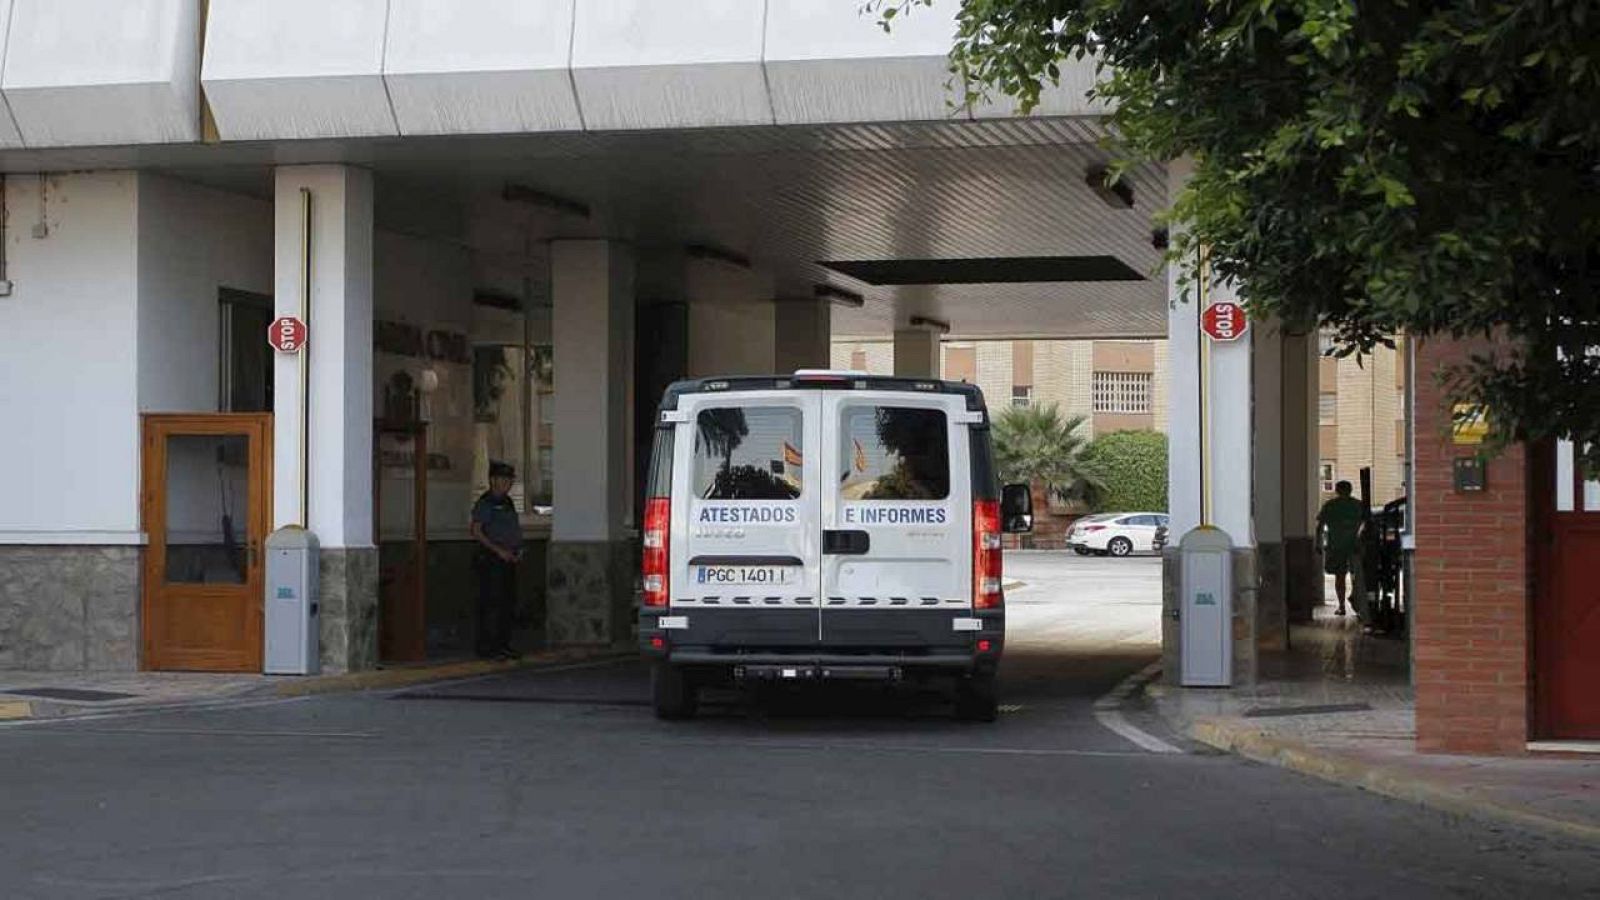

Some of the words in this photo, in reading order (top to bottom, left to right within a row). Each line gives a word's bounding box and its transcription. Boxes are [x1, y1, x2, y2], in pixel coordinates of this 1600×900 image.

[1215, 304, 1233, 337] STOP
[280, 319, 295, 350] STOP
[699, 507, 795, 522] ATESTADOS
[845, 508, 855, 523] E
[860, 508, 946, 523] INFORMES
[707, 568, 736, 582] PGC
[741, 568, 774, 582] 1401
